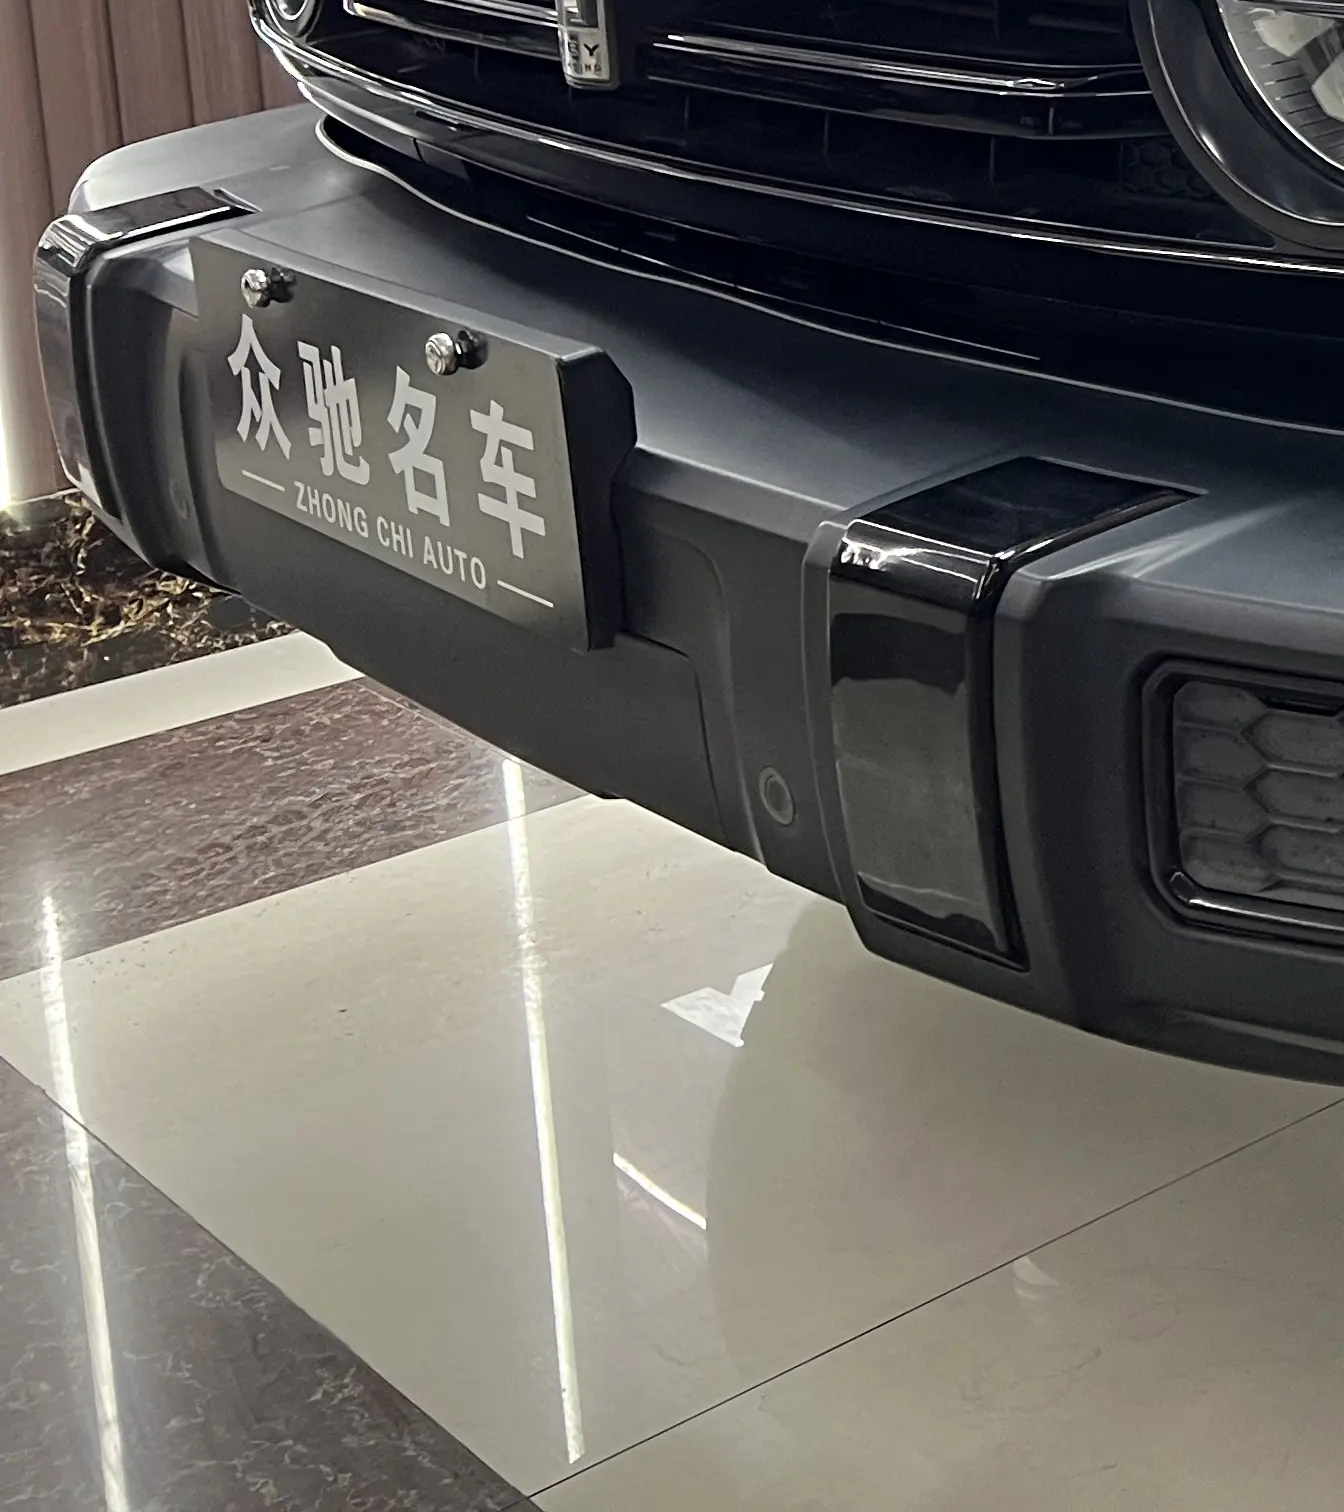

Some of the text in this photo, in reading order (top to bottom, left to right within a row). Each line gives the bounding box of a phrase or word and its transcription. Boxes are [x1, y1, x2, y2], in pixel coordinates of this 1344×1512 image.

[227, 313, 547, 560] 众驰名车
[294, 480, 487, 590] ZHONG CHI AUTO
